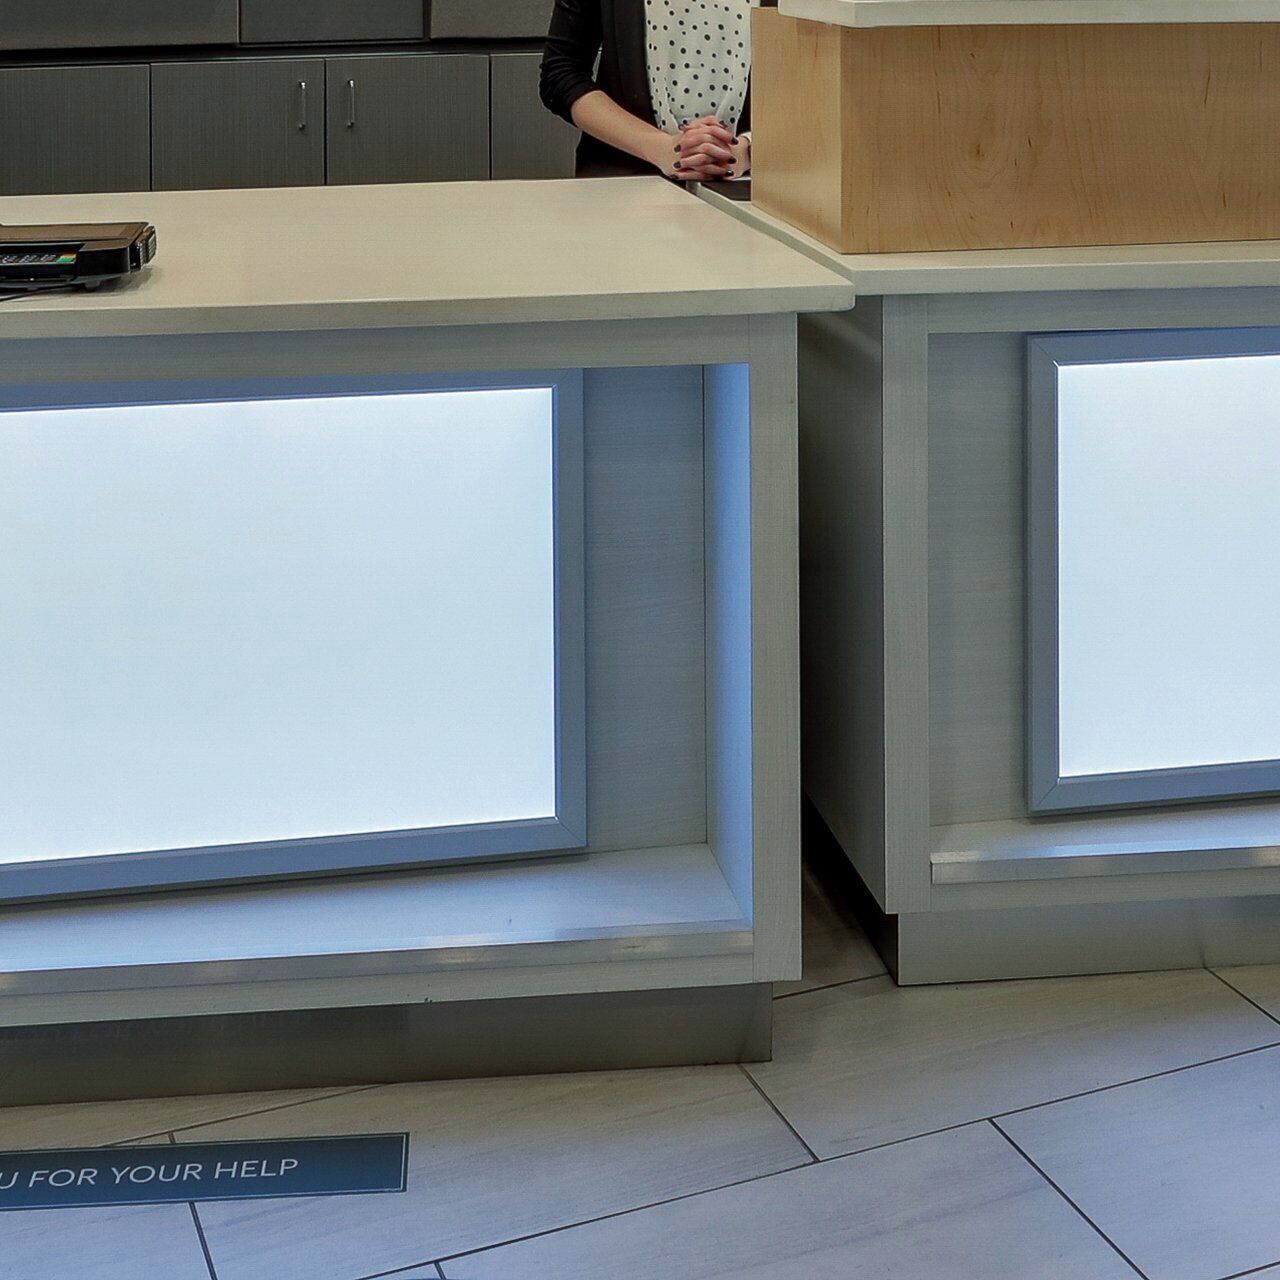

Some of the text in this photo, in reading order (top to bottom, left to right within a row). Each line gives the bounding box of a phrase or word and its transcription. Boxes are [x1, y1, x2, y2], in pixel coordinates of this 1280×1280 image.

[28, 1168, 99, 1188] FOR
[111, 1163, 202, 1184] YOUR
[214, 1158, 299, 1180] HELP
